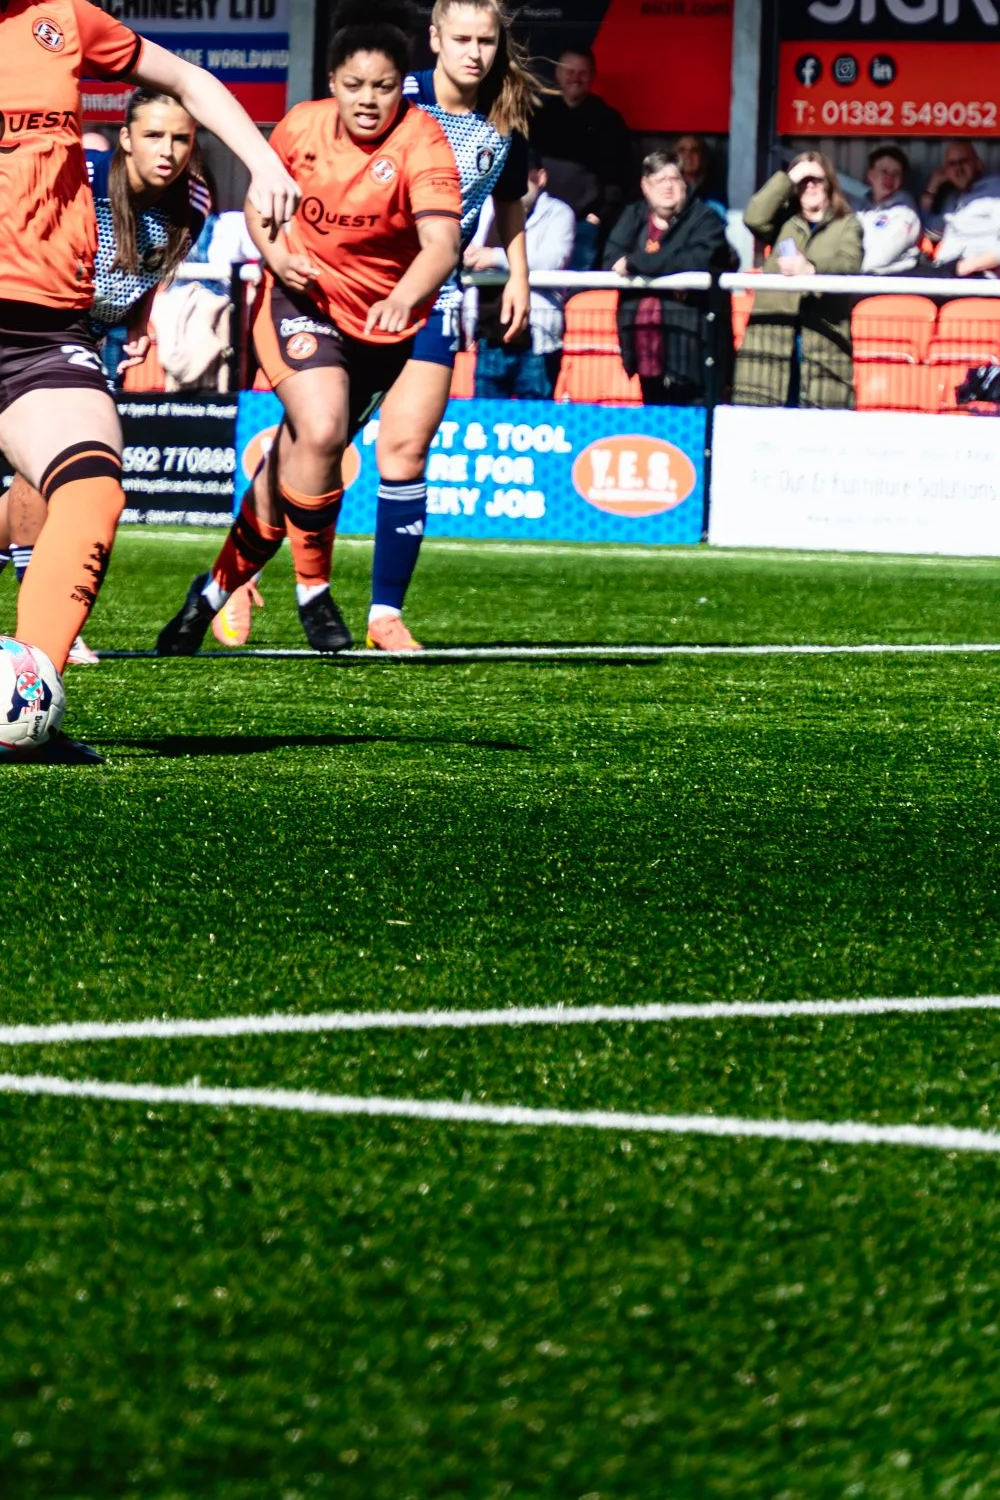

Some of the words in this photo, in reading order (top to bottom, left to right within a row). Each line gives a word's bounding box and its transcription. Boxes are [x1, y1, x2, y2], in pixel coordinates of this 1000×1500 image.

[792, 100, 816, 125] T:
[821, 100, 895, 126] 01382
[901, 101, 998, 128] 549052
[302, 197, 381, 235] QUEST
[493, 422, 573, 453] TOOL
[475, 454, 535, 485] FOR
[485, 488, 546, 519] JOB
